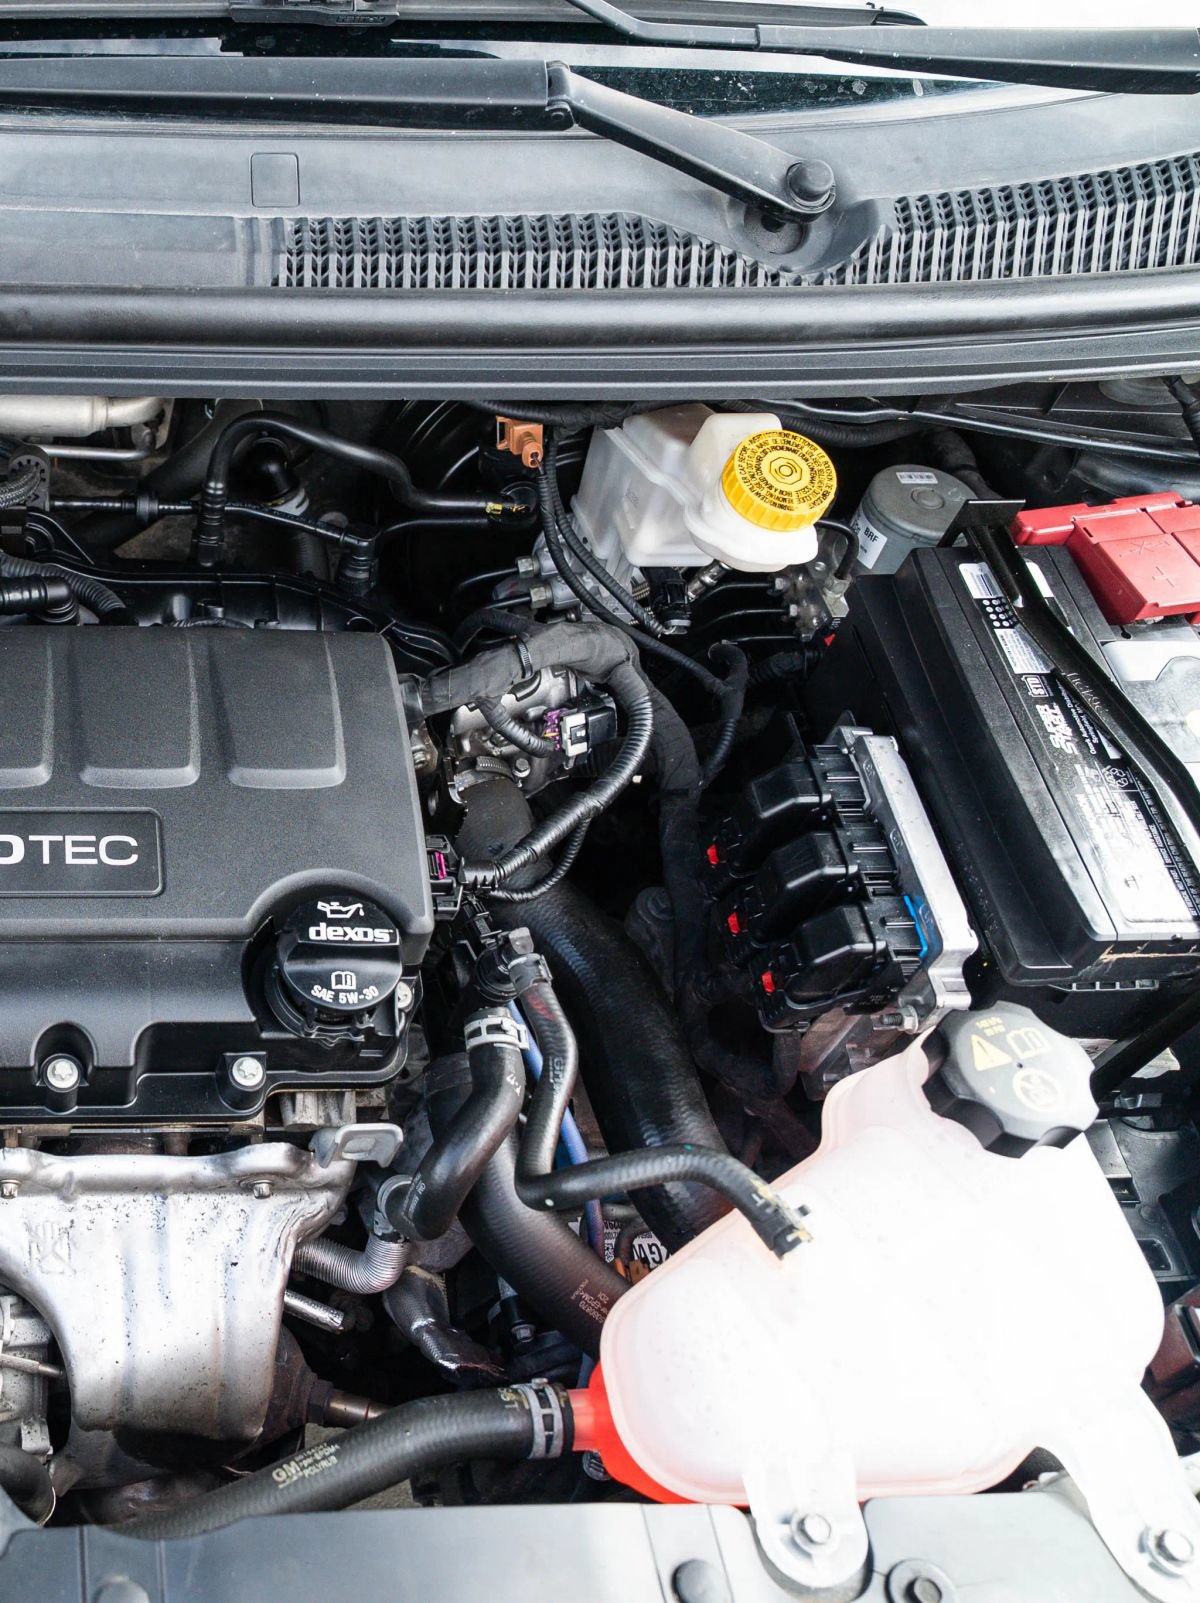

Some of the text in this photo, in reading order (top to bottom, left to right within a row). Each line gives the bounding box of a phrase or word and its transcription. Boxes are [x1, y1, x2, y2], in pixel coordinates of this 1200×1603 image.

[864, 527, 879, 543] BRF
[1026, 677, 1044, 693] STD
[1070, 708, 1088, 736] Automotive
[308, 922, 391, 943] dexos
[310, 984, 379, 1004] SAE 5W-30
[270, 1460, 301, 1483] GM
